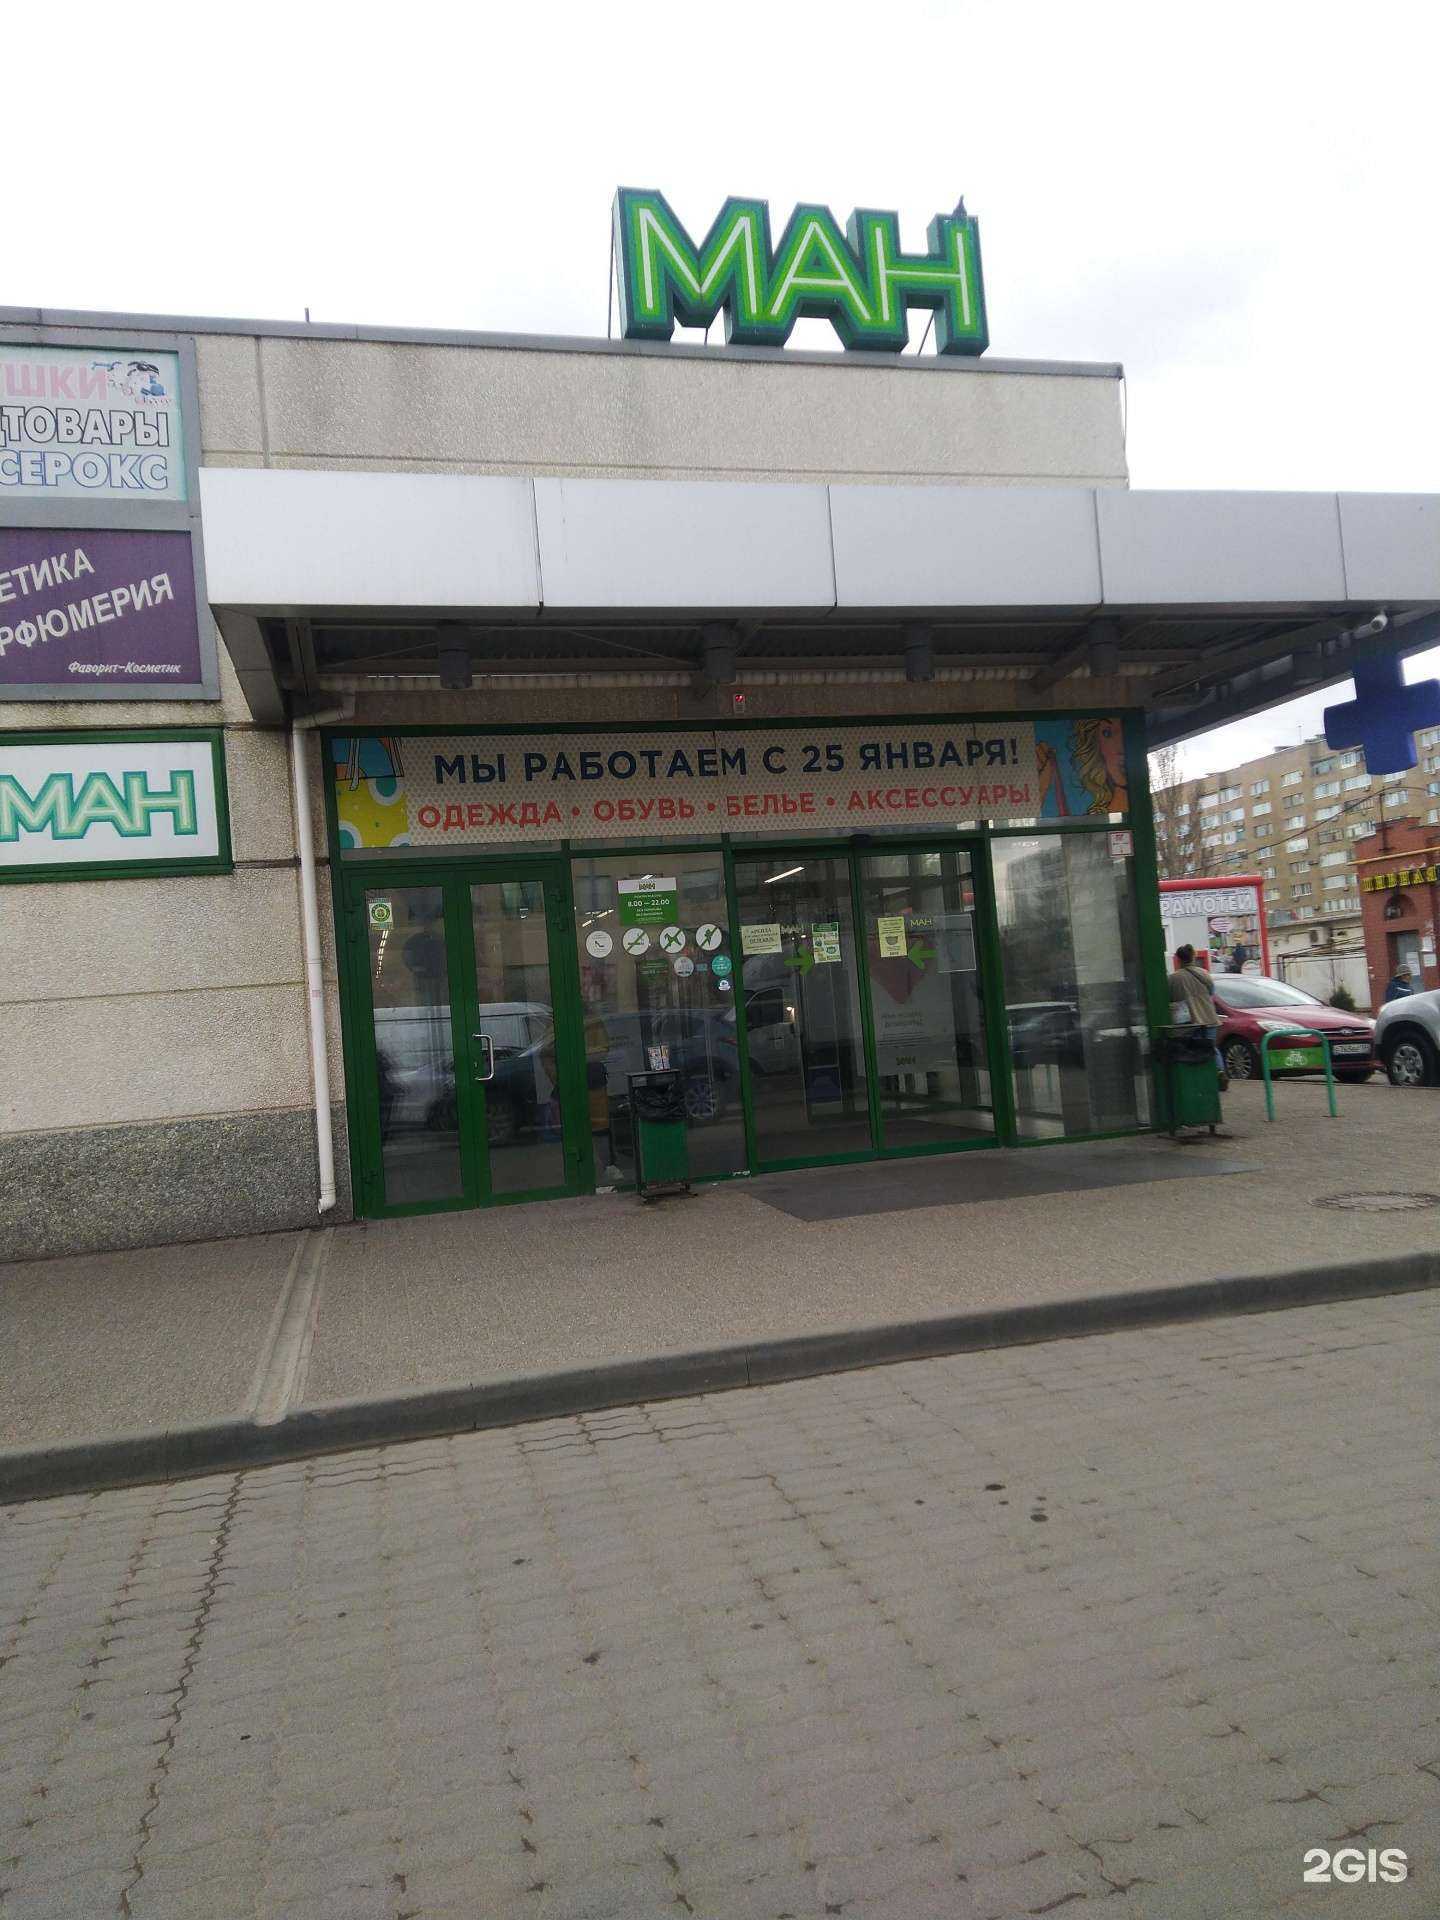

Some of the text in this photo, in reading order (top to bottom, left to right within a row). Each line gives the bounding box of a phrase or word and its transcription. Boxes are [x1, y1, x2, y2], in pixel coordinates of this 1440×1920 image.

[614, 186, 990, 357] МАН
[68, 660, 181, 676] Фаворит-Косметик
[434, 738, 1019, 785] МЫ РАБОТАЕМ С 25 ЯНВАРЯ!
[0, 769, 198, 842] МАН
[417, 783, 1031, 832] ОДЕЖДА ОБУВЬ БЕЛЬЕ АКСЕССУАРЫ
